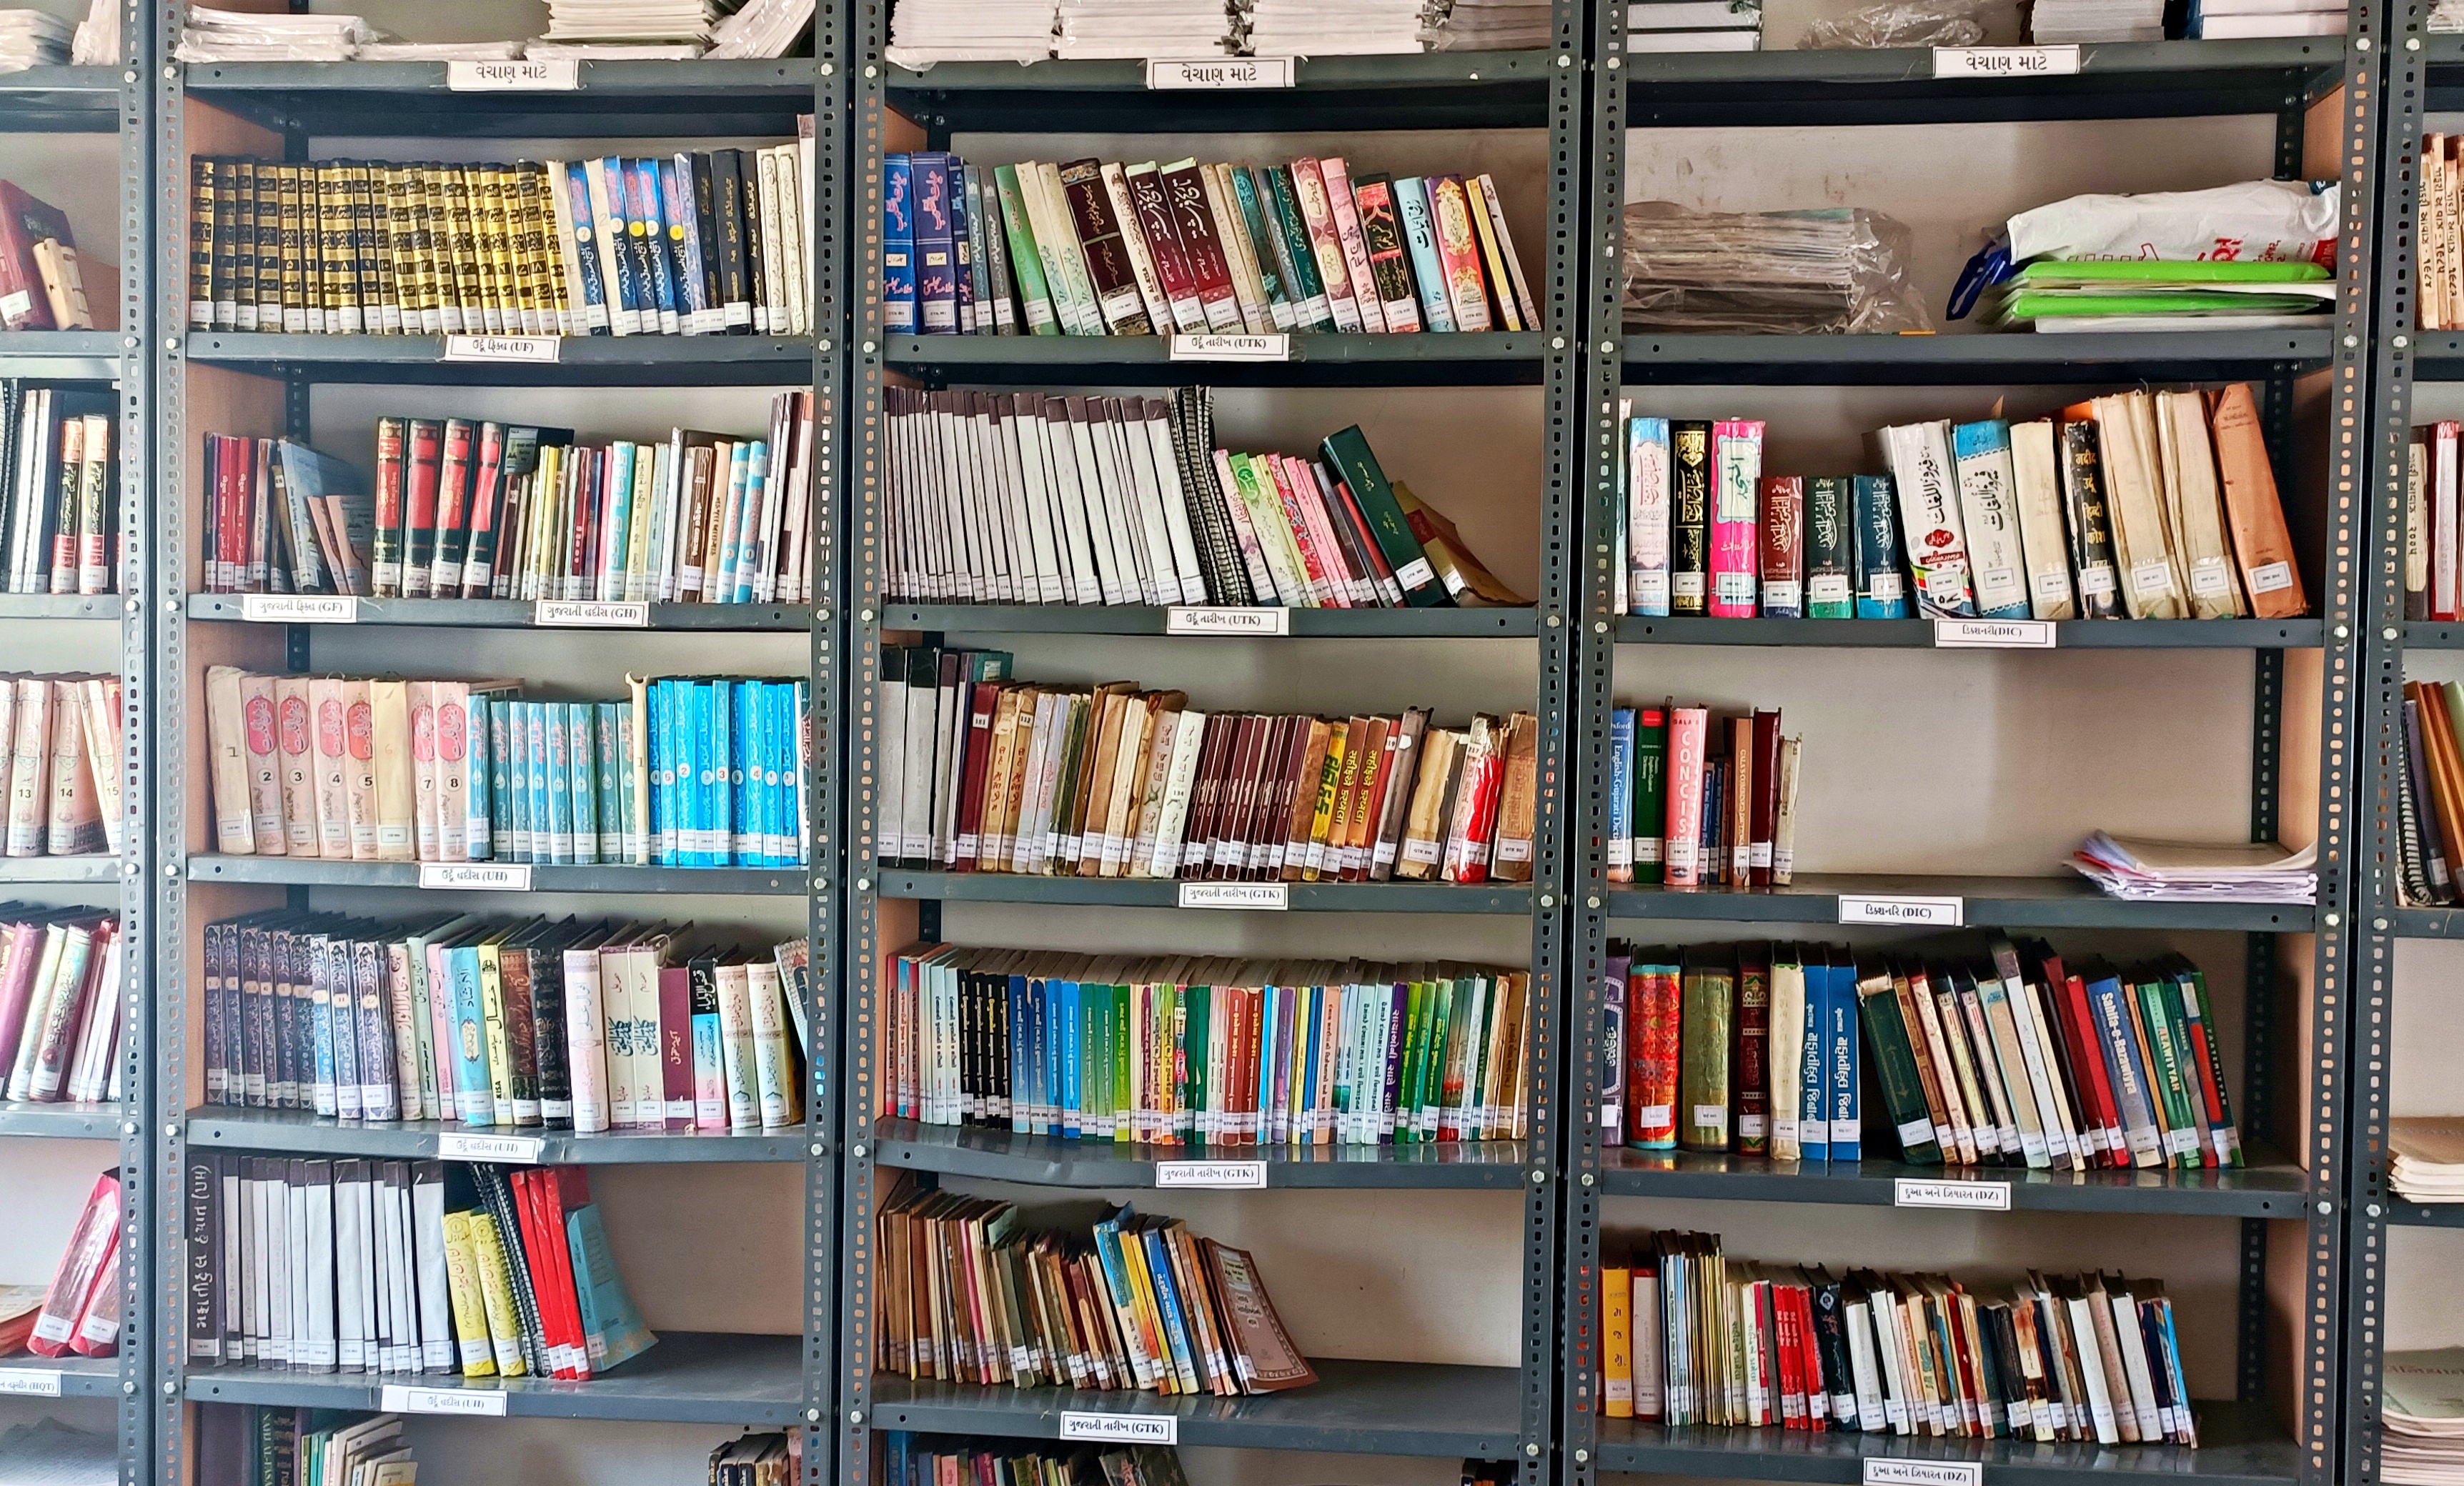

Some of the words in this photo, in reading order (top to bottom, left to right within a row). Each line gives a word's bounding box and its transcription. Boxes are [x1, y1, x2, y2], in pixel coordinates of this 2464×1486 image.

[1966, 51, 2012, 74] વેચાણ
[2020, 51, 2048, 70] માટે
[476, 63, 516, 83] વેચાણ
[522, 63, 547, 79] માટે
[1182, 63, 1224, 86] વેચાણ
[1231, 63, 1258, 81] માટે
[473, 338, 486, 352] ઉર્દૂ
[510, 341, 534, 352] (UF)
[1191, 335, 1203, 350] ઉર્દૂ
[1206, 336, 1233, 349] તારીખ
[1234, 339, 1266, 349] (UTK)
[2082, 474, 2097, 493] उर्दू
[2082, 502, 2102, 519] हिन्दी
[259, 600, 293, 615] ગુજરાતી
[318, 602, 342, 612] (GF)
[547, 605, 582, 619] ગુજરાતી
[585, 605, 607, 617] હદીસ
[611, 608, 637, 619] (GH)
[1186, 612, 1198, 625] ઉર્દૂ
[1200, 612, 1226, 624] તારીખ
[1228, 614, 1261, 626] (UTK)
[1612, 722, 1630, 731] xford
[263, 772, 272, 782] 2
[294, 772, 302, 782] 3
[332, 774, 340, 784] 4
[364, 777, 372, 787] 5
[423, 779, 432, 789] 7
[450, 779, 458, 788] 8
[1613, 745, 1624, 814] English-Gujarati
[19, 789, 31, 799] 13
[60, 788, 73, 798] 14
[106, 787, 119, 797] 15
[1335, 789, 1349, 826] કરબલા
[1355, 789, 1368, 824] કરબલા
[442, 868, 454, 883] ઉર્દૂ
[457, 869, 480, 880] હદીસ
[482, 870, 508, 882] (UH)
[1189, 888, 1220, 900] ગુજરાતી
[1222, 889, 1247, 899] તારીખ
[1250, 890, 1280, 900] (GTK)
[1902, 907, 1932, 918] (DIC)
[1837, 1093, 1851, 1120] જિના
[470, 1140, 492, 1151] હદીસ
[1164, 1168, 1193, 1180] ગુજરાતી
[1197, 1169, 1220, 1179] તારીખ
[1223, 1170, 1253, 1180] (GTK)
[1905, 1188, 1922, 1199] દુઆ
[1924, 1188, 1940, 1197] અને
[1943, 1188, 1972, 1200] ઝિયારત
[1975, 1191, 1998, 1201] (DZ)
[193, 1206, 209, 1244] હયાત
[29, 1382, 54, 1392] (HQT)
[441, 1397, 460, 1407] હદીસ
[1068, 1419, 1101, 1432] ગુજરાતી
[1103, 1421, 1128, 1432] તારીખ
[1131, 1422, 1164, 1435] (GTK)
[1872, 1466, 1889, 1479] દુઆ
[1892, 1467, 1907, 1476] અને
[1910, 1467, 1941, 1480] ઝિયારત
[1943, 1470, 1967, 1482] (DZ)
